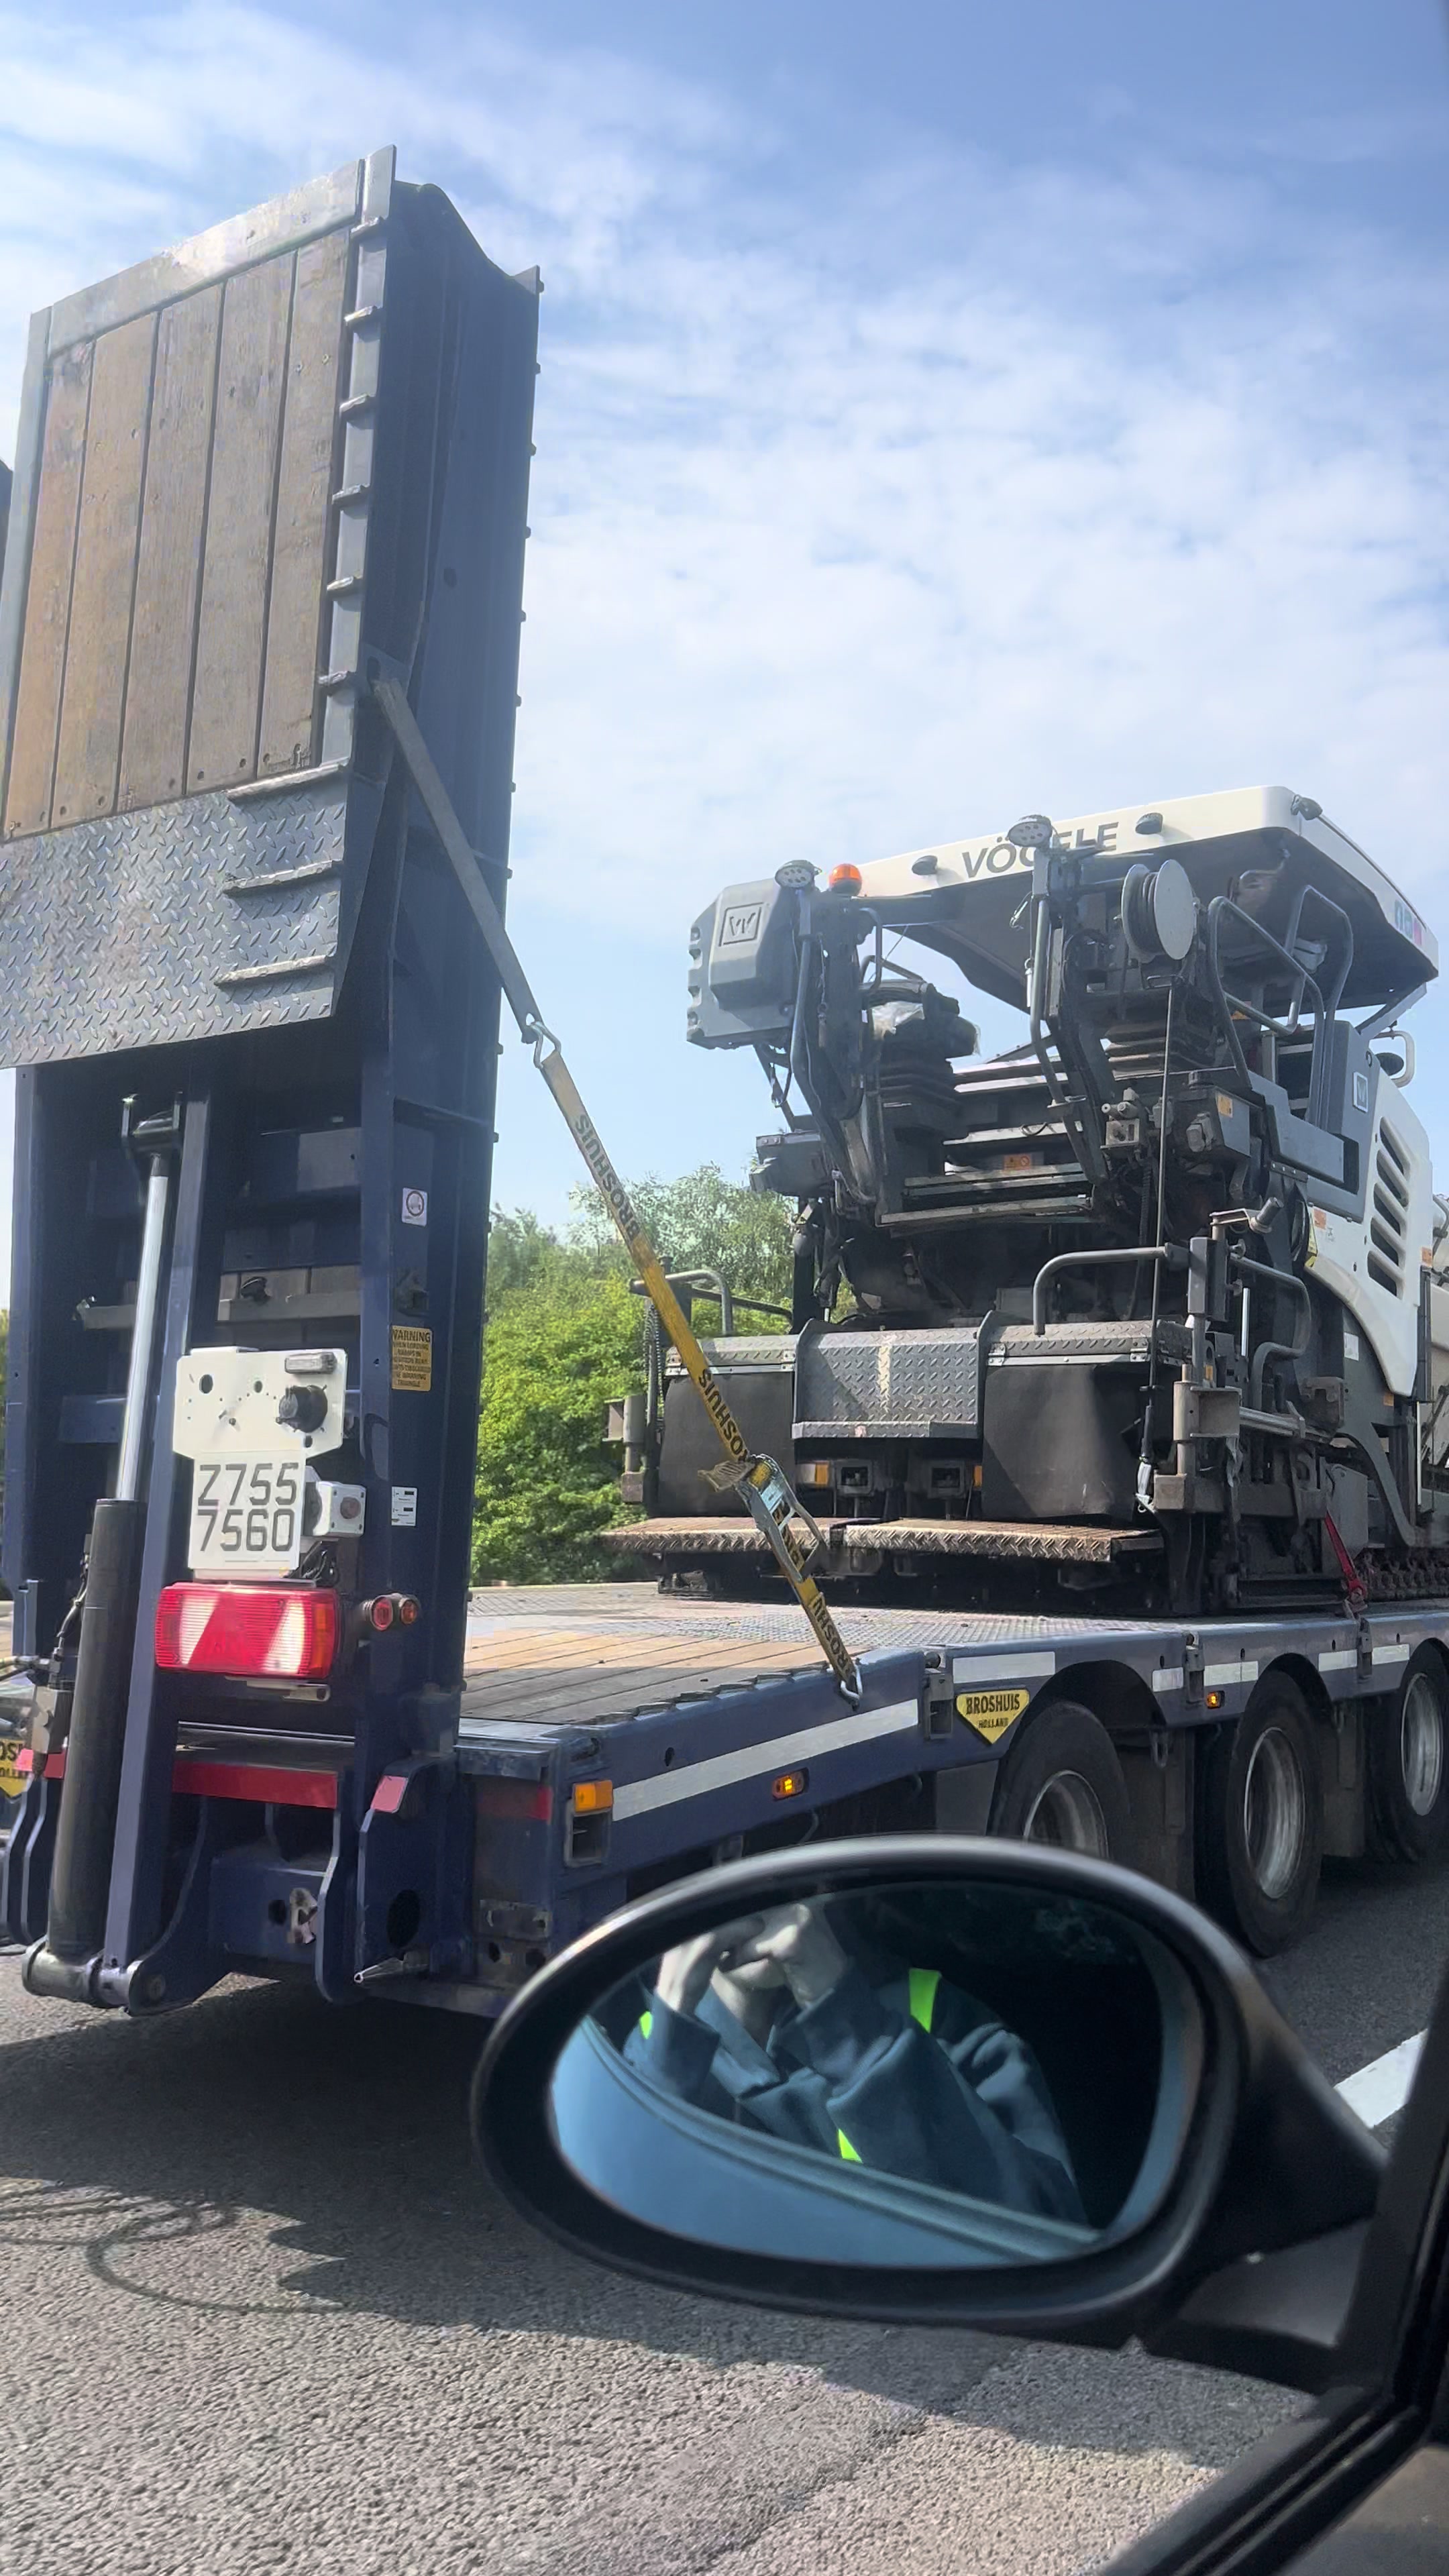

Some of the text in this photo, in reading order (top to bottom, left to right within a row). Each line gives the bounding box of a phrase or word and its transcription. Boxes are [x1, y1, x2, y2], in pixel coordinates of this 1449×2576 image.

[576, 1114, 641, 1242] BROSHUIS
[197, 1462, 299, 1507] Z755
[197, 1507, 295, 1552] 7560
[965, 1693, 1020, 1715] BROSHUIS
